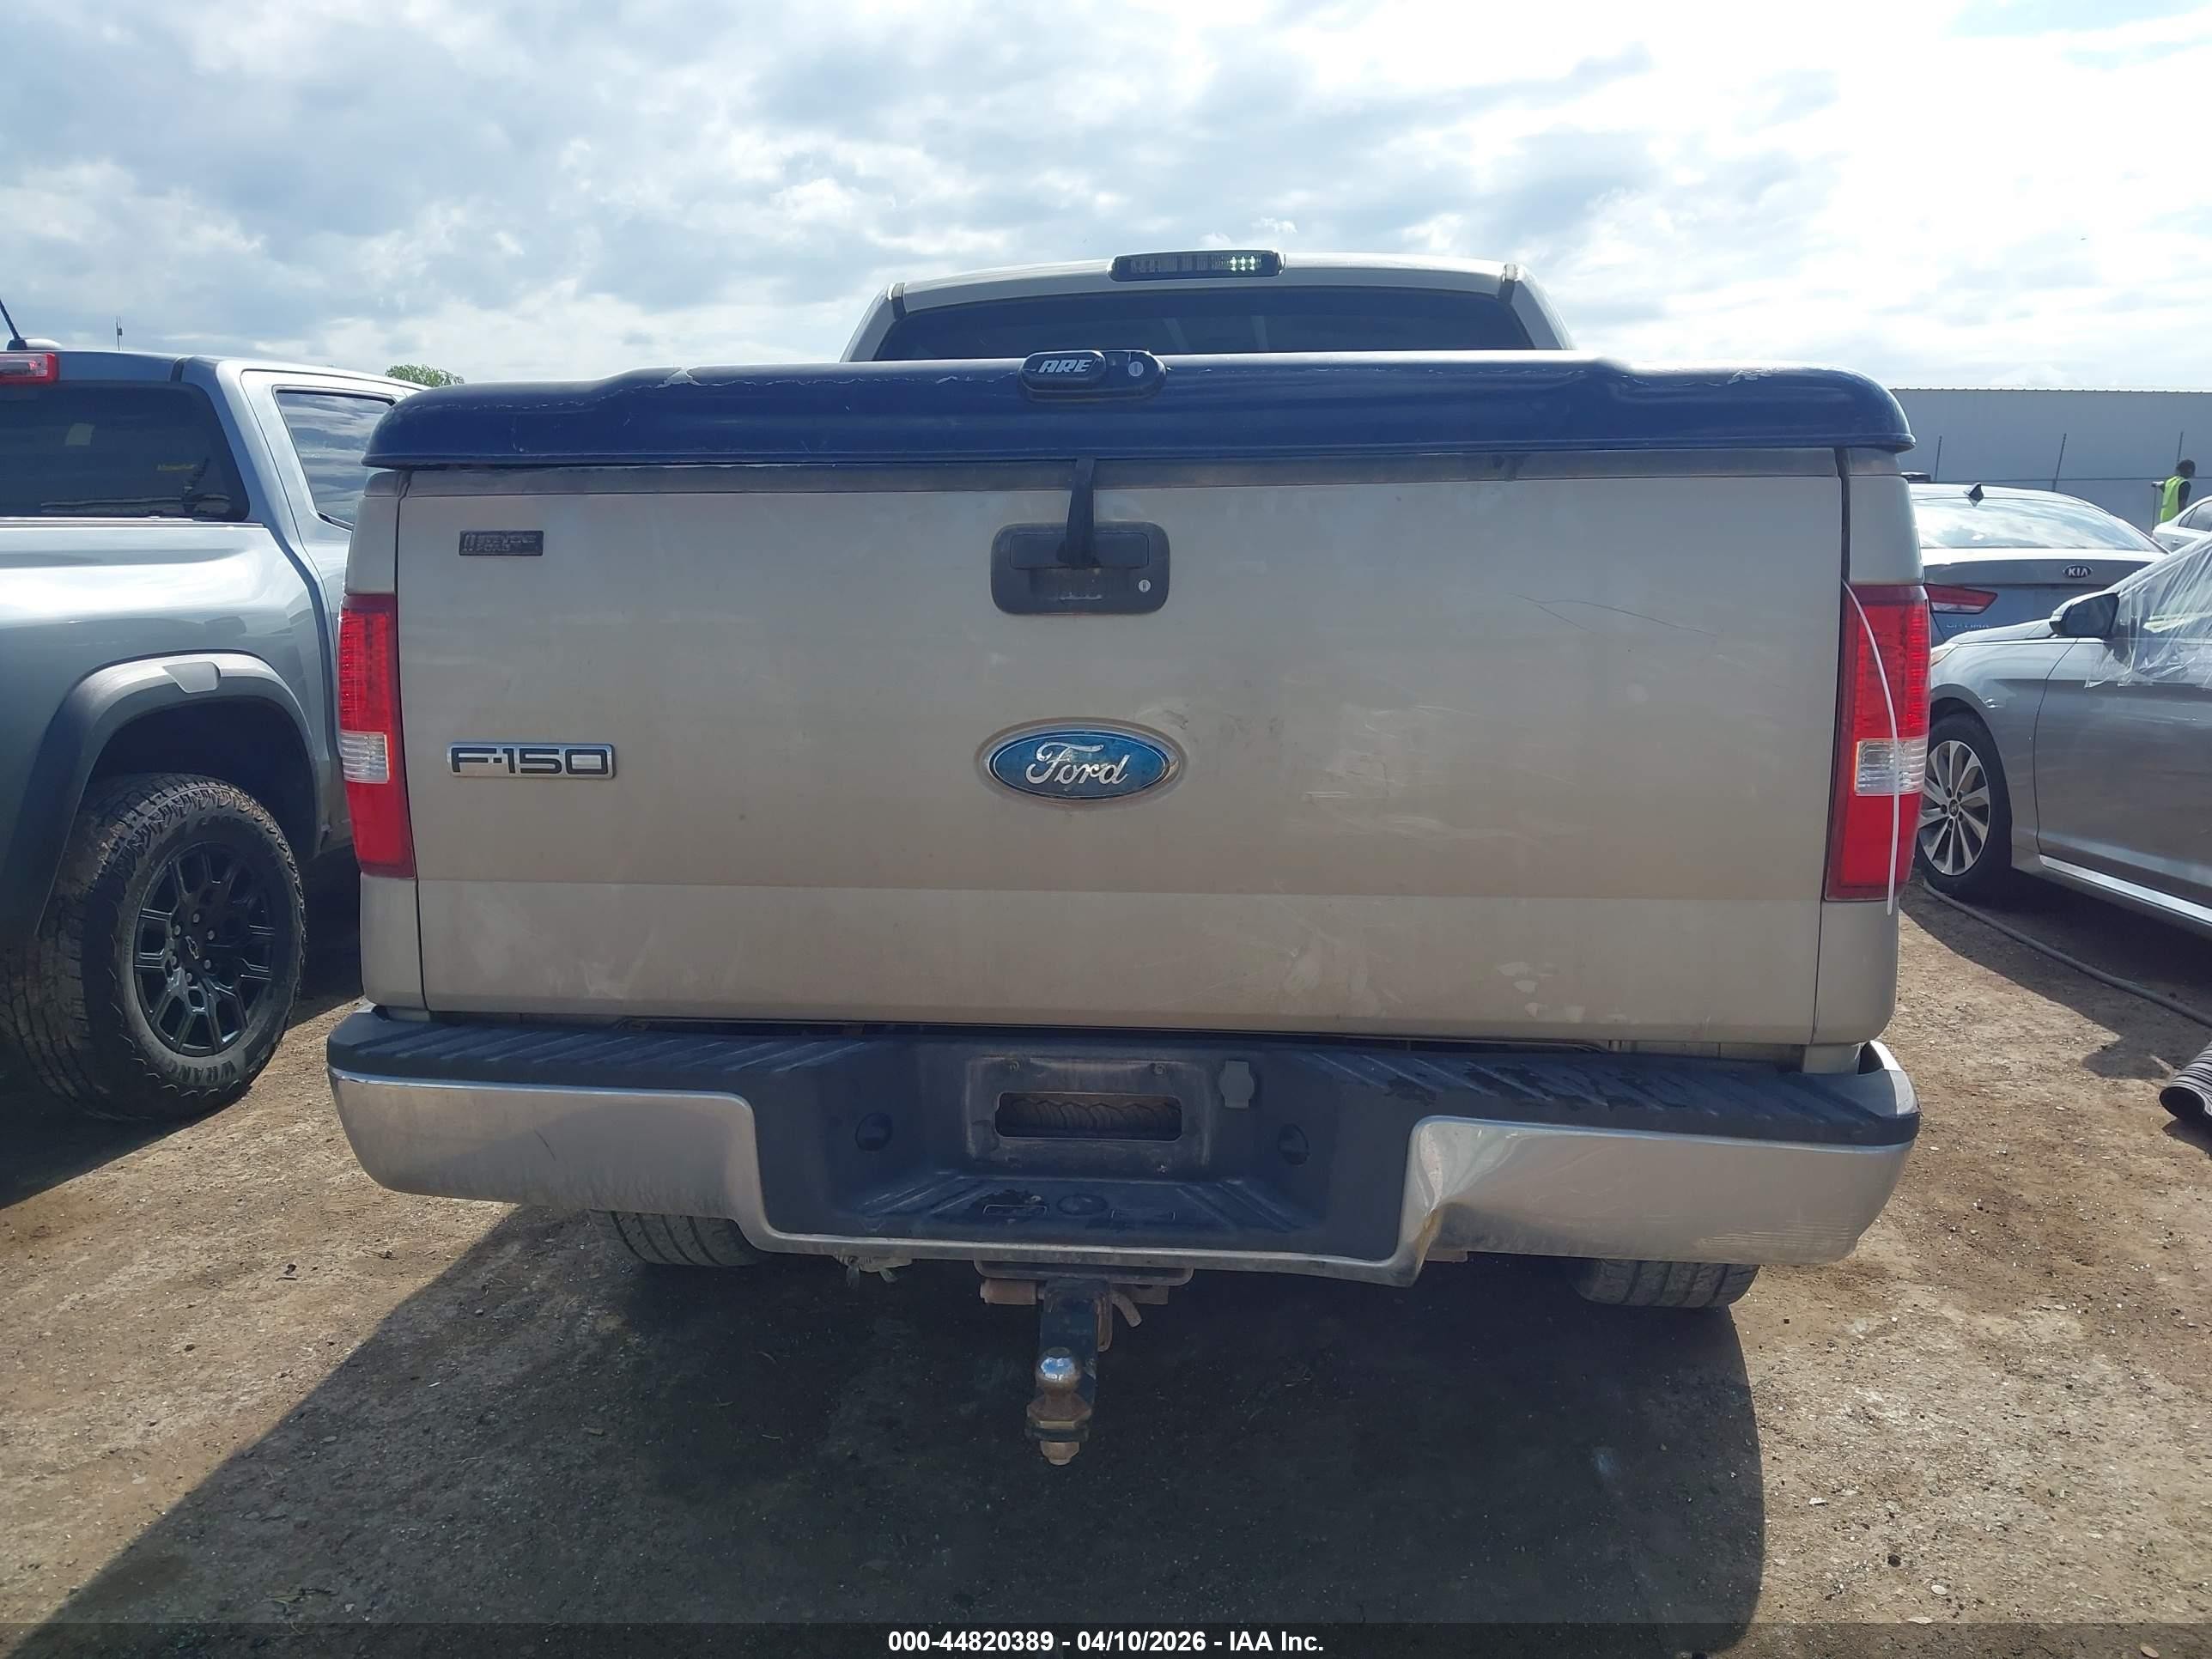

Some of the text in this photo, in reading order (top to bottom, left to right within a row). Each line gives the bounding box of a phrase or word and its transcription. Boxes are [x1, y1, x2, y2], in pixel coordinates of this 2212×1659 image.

[1038, 359, 1093, 374] ARE
[2068, 568, 2088, 577] KIA
[450, 747, 609, 775] F-150
[1025, 741, 1130, 785] Ford
